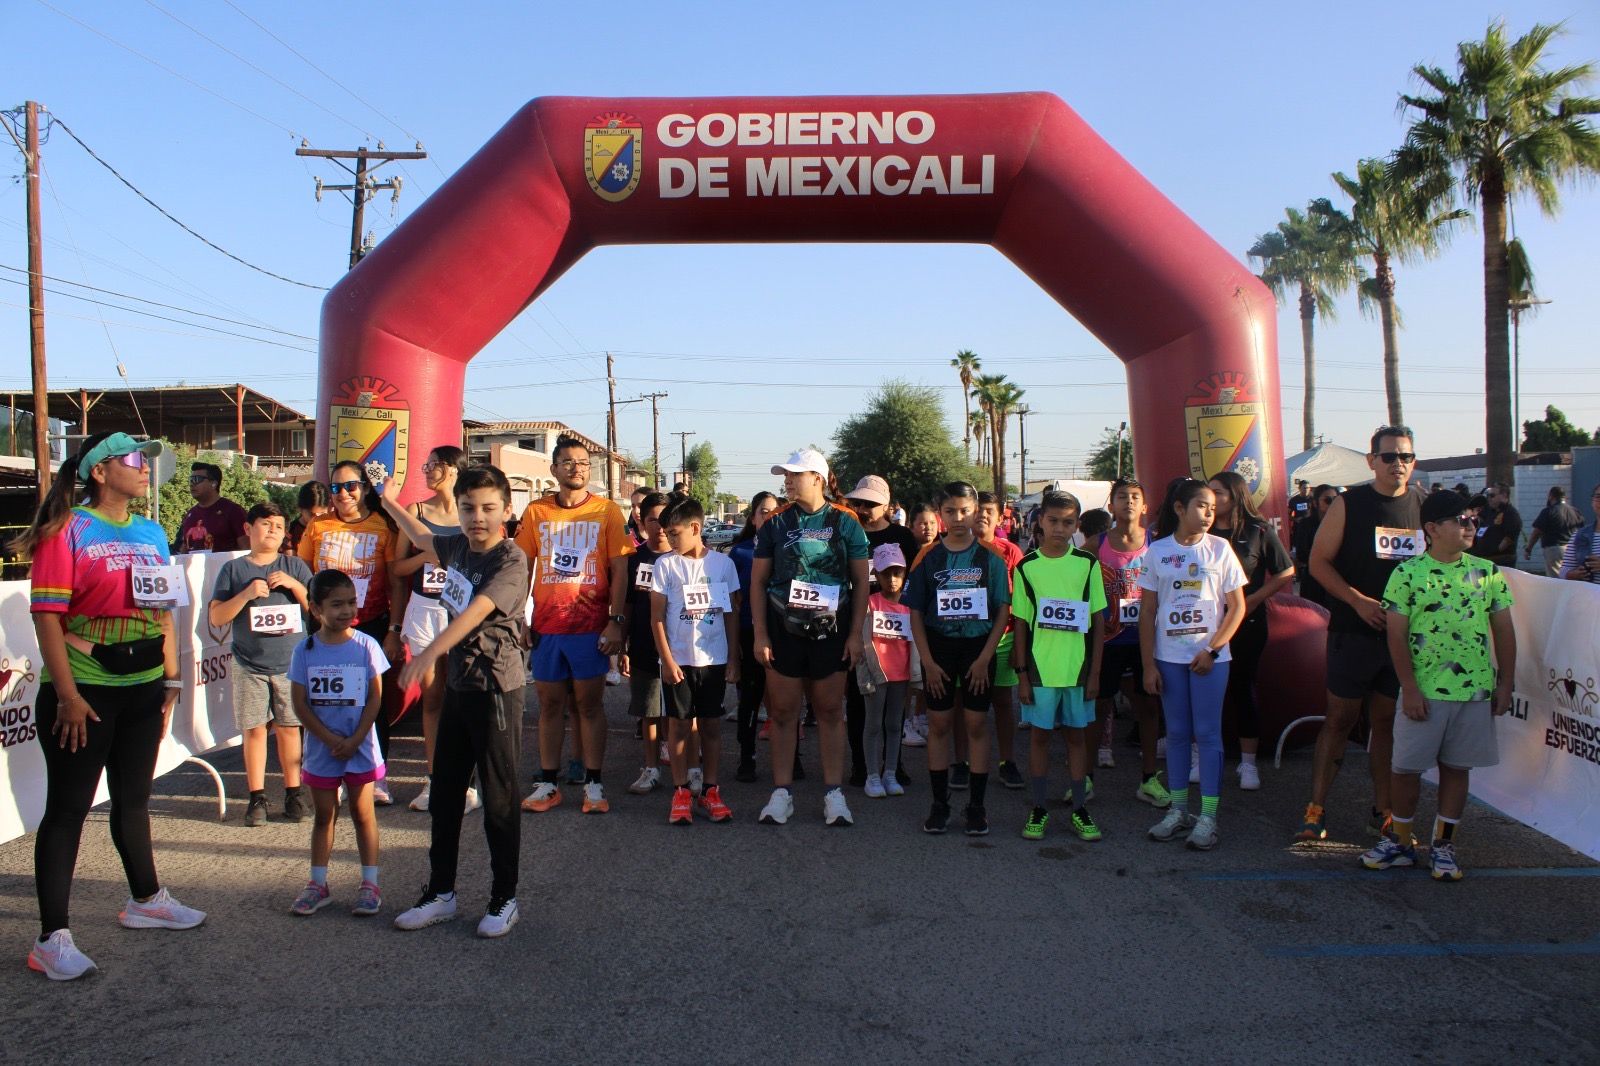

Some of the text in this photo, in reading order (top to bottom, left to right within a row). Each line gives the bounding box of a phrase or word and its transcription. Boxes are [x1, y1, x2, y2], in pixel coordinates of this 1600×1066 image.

[657, 110, 936, 147] GOBIERNO
[658, 154, 995, 198] DE MEXICALI
[341, 407, 393, 419] Mexi Cali
[1202, 406, 1223, 415] Mexi
[1379, 535, 1414, 551] 004
[554, 552, 579, 569] 291
[133, 576, 169, 595] 058
[445, 578, 465, 606] 286
[687, 592, 709, 605] 311
[792, 588, 820, 602] 312
[940, 597, 973, 611] 305
[254, 613, 287, 628] 289
[679, 613, 704, 621] CANAL
[1042, 605, 1076, 621] 063
[1169, 609, 1204, 625] 065
[875, 618, 903, 632] 202
[310, 677, 344, 694] 216
